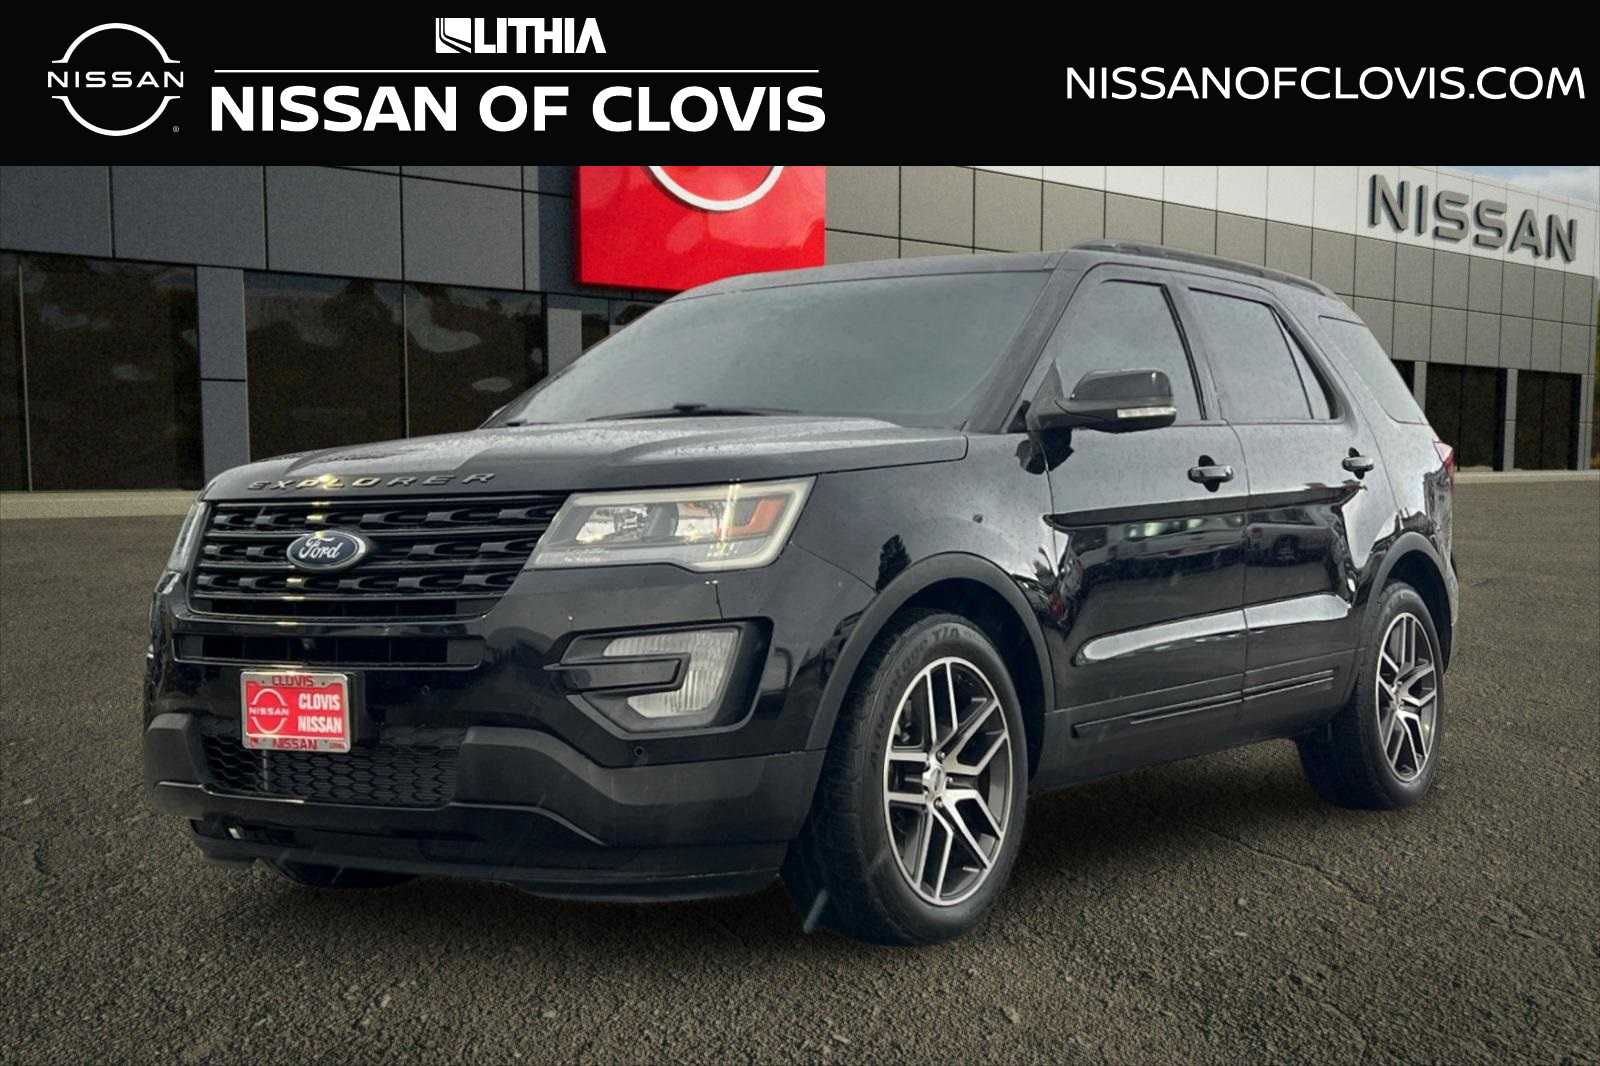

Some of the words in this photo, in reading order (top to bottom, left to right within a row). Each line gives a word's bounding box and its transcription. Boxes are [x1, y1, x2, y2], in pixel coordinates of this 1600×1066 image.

[1369, 174, 1577, 262] NISSAN
[247, 472, 496, 491] EXPLORER
[298, 536, 344, 560] Ford
[271, 675, 315, 687] CLOVIS
[248, 706, 290, 716] NISSAN
[298, 692, 341, 711] CLOVIS
[297, 715, 343, 734] NISSAN
[271, 737, 318, 750] NISSAN
